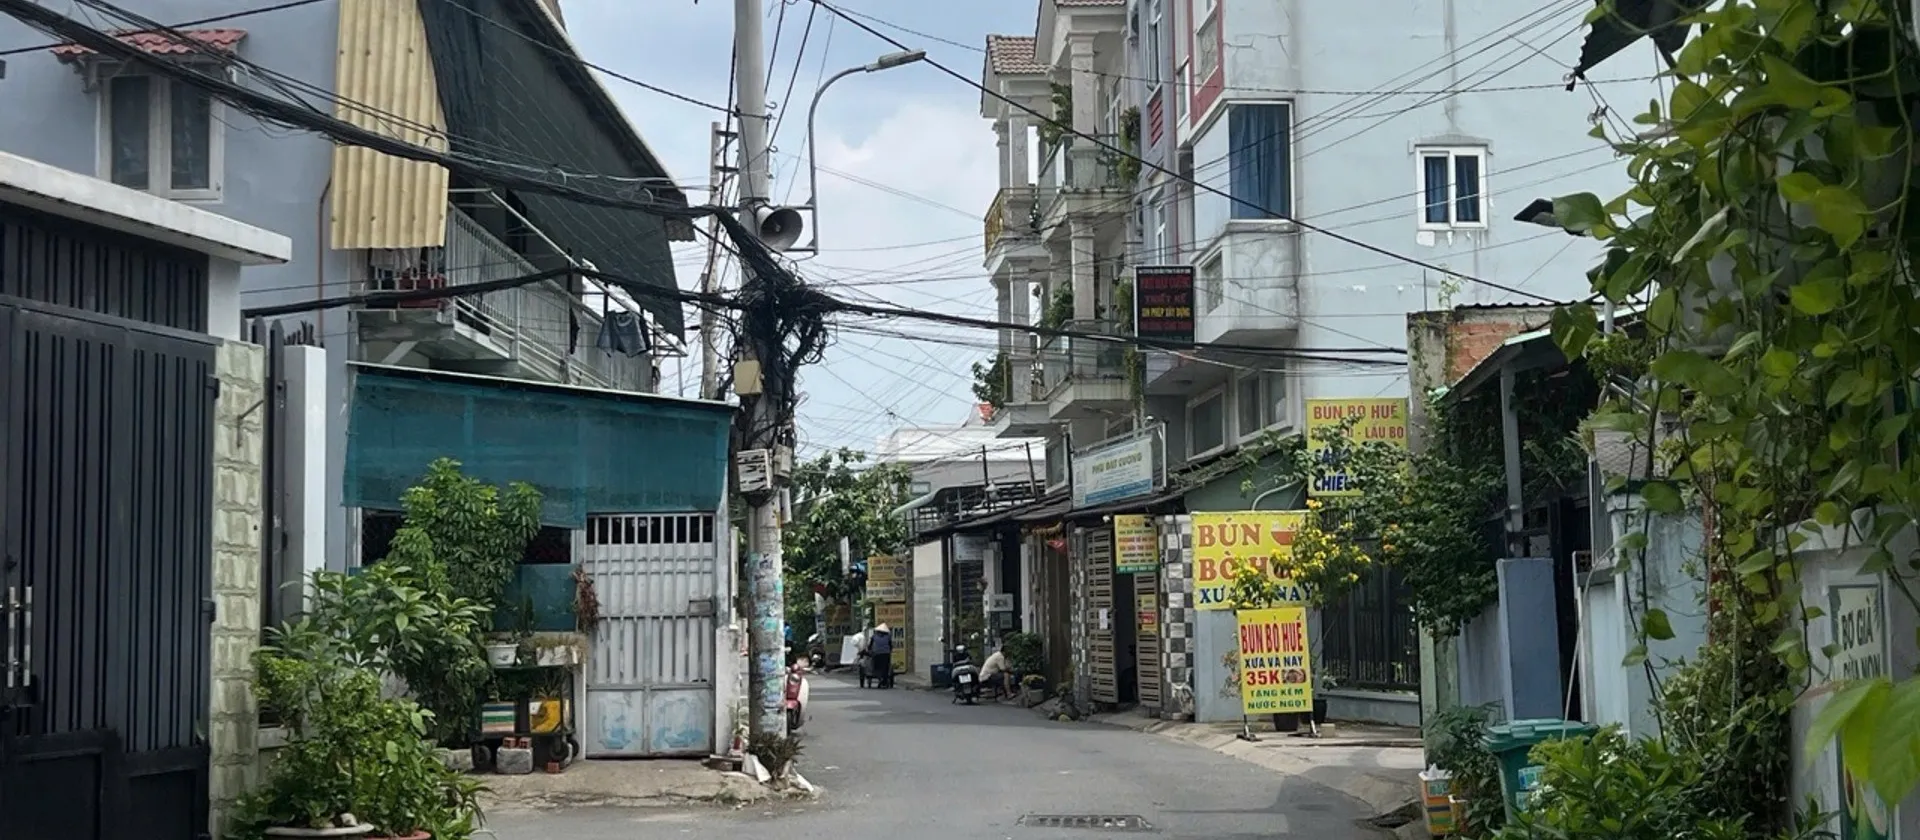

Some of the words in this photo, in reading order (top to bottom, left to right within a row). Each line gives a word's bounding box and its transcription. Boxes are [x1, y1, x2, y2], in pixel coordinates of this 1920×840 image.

[1313, 402, 1342, 420] BÚN
[1371, 402, 1398, 419] HUẾ
[1198, 517, 1262, 547] BÚN
[1198, 551, 1239, 581] BÒ
[1240, 618, 1264, 654] BÚN
[1265, 616, 1280, 653] BÒ
[1281, 612, 1303, 652] HUẾ
[1283, 655, 1303, 667] NAY
[1246, 669, 1280, 686] 35K
